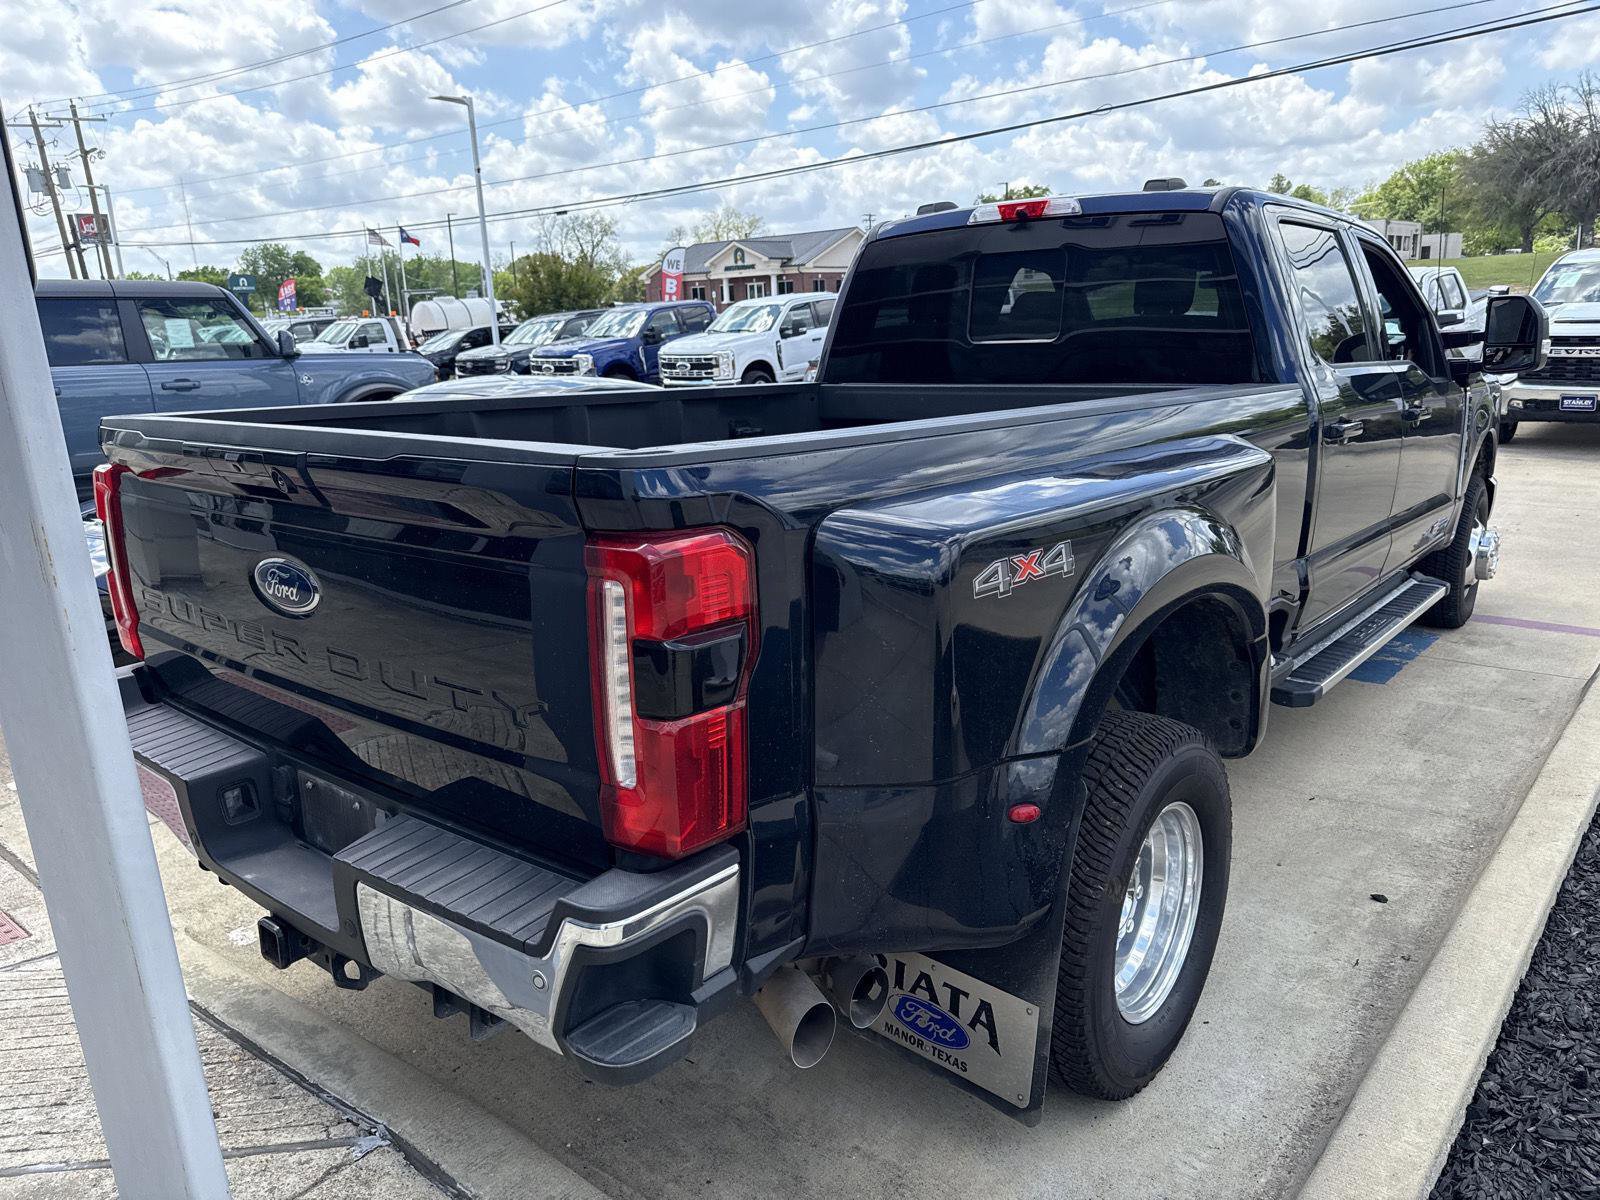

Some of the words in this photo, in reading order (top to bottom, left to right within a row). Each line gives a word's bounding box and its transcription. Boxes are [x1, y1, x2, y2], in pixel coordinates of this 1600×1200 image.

[667, 259, 680, 270] WE
[265, 568, 300, 602] Ford
[141, 590, 308, 664] SUPER
[326, 646, 551, 729] DUTY
[900, 1001, 957, 1041] Ford
[931, 1045, 968, 1073] TEXAS
